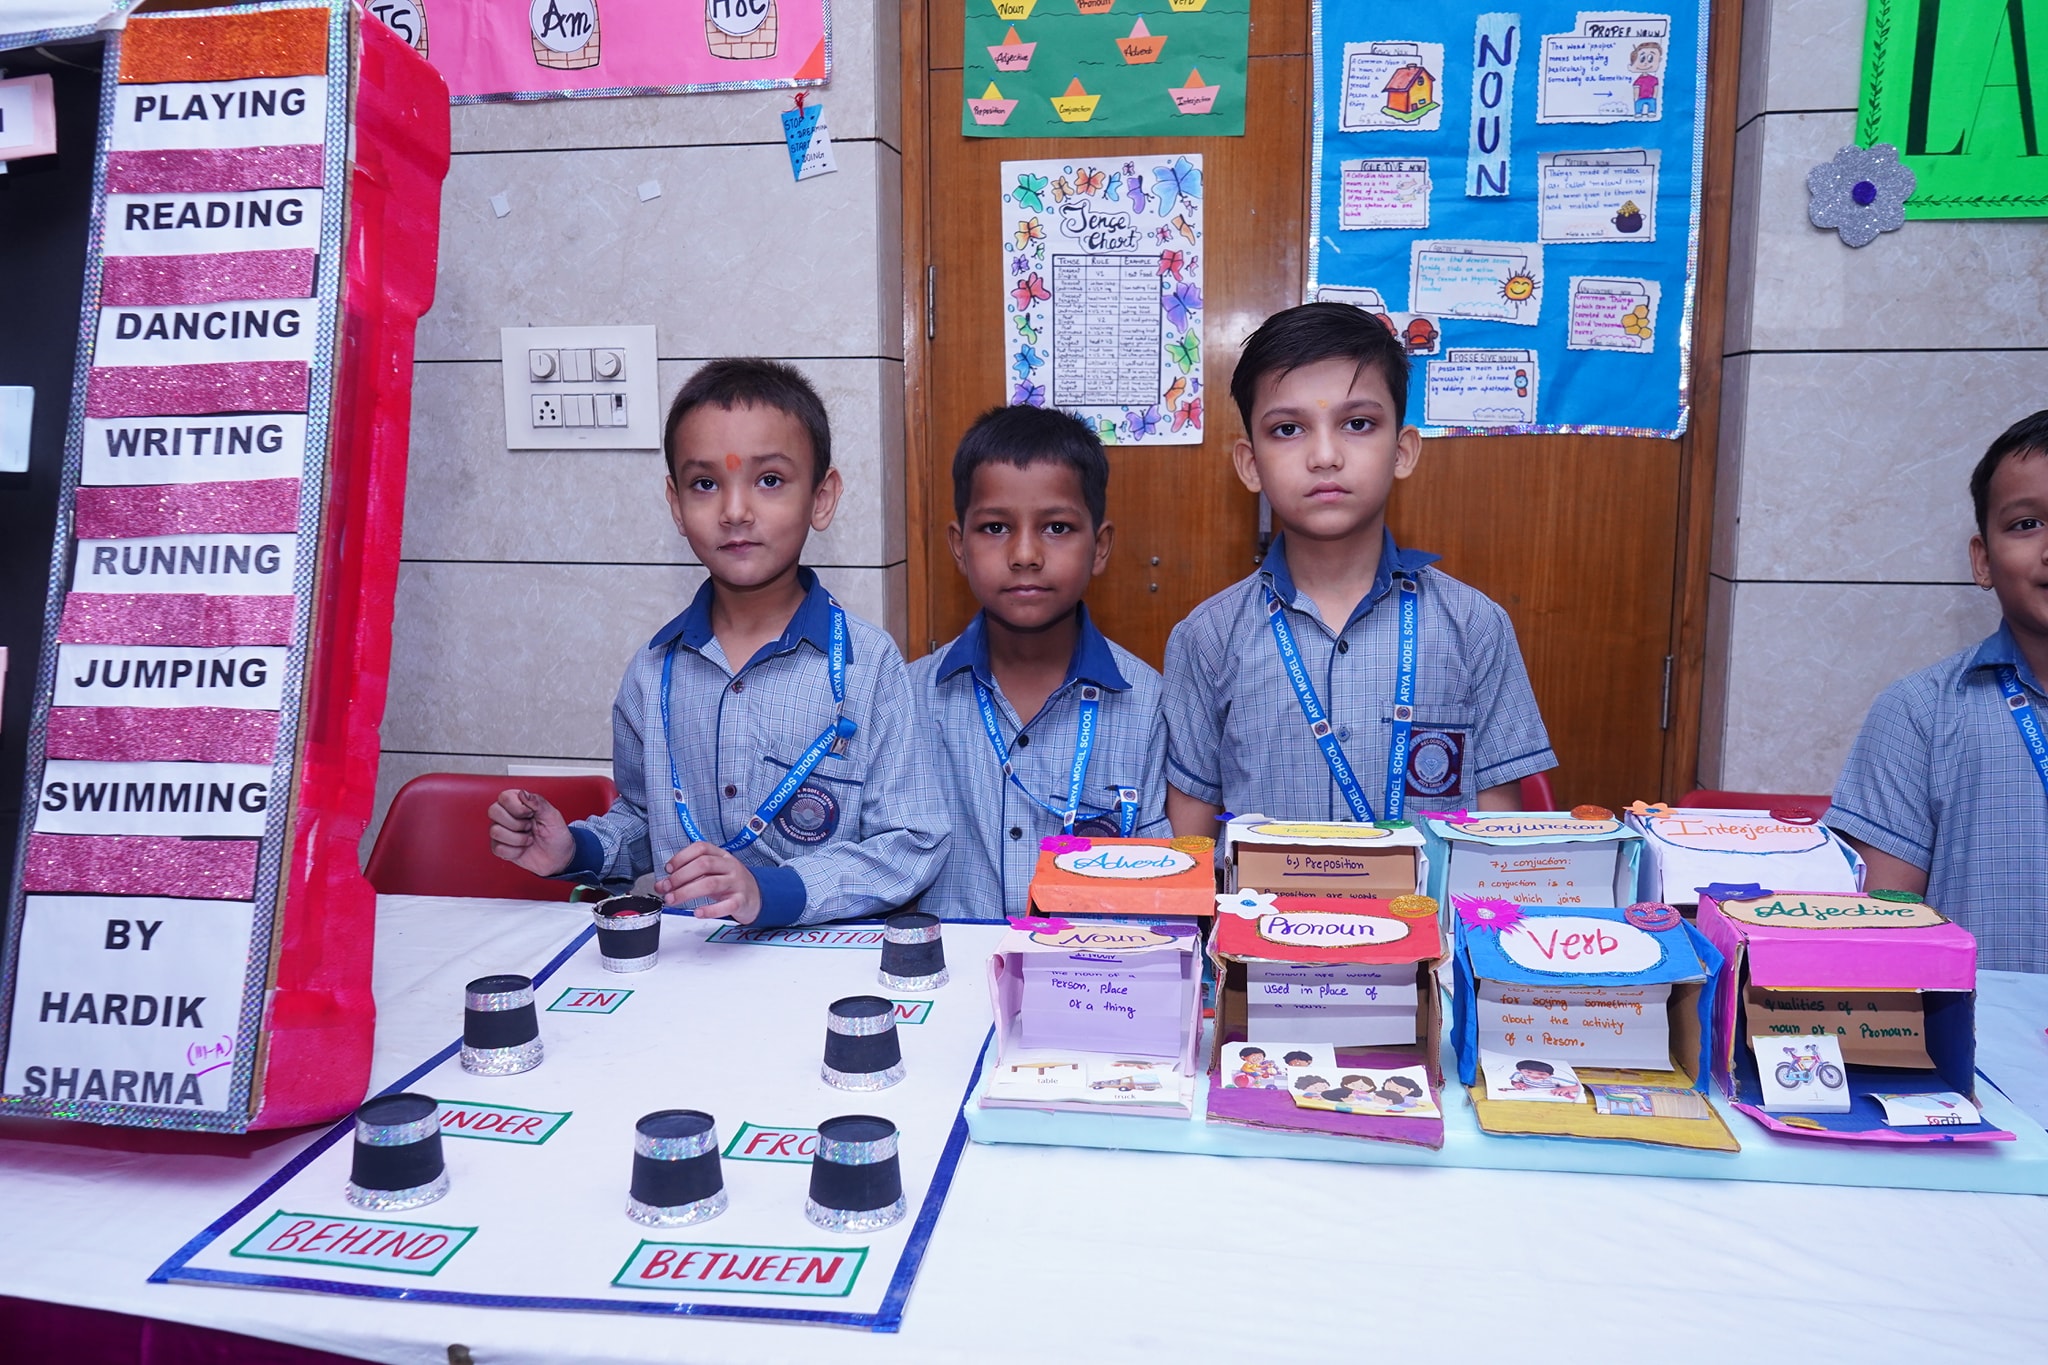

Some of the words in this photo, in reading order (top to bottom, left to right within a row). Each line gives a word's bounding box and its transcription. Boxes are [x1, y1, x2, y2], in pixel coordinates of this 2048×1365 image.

[541, 0, 591, 37] Am
[998, 3, 1024, 15] Noun
[995, 53, 1028, 65] Adjective
[1124, 44, 1153, 57] Adverb
[1550, 41, 1563, 50] The
[133, 89, 307, 122] PLAYING
[1059, 104, 1091, 115] Conjunction
[784, 117, 805, 131] STOP
[791, 140, 810, 154] START
[124, 199, 304, 231] READING
[1084, 230, 1137, 250] Chart
[1091, 257, 1110, 265] RULE
[1124, 257, 1152, 265] EXAMPLE
[115, 309, 301, 341] DANCING
[106, 425, 284, 457] WRITING
[92, 545, 282, 575] RUNNING
[833, 611, 843, 643] SCHOOL
[1403, 599, 1413, 637] SCHOOL
[1275, 617, 1295, 657] SCHOOL
[833, 644, 843, 672] MODEL
[1402, 637, 1413, 674] MODEL
[73, 658, 268, 689] JUMPING
[833, 672, 843, 699] ARYA
[1289, 655, 1308, 692] MODEL
[1400, 674, 1411, 703] ARYA
[983, 702, 997, 736] MODEL
[1303, 691, 1320, 719] ARYA
[818, 729, 836, 751] ARYA
[1080, 708, 1093, 749] SCHOOL
[2021, 714, 2046, 755] SCHOOL
[995, 735, 1007, 760] ARYA
[1392, 730, 1407, 775] SCHOOL
[794, 747, 822, 779] MODEL
[1073, 749, 1087, 786] MODEL
[1326, 741, 1352, 786] SCHOOL
[44, 781, 268, 814] SWIMMING
[764, 778, 798, 814] SCHOOL
[1069, 786, 1080, 809] ARYA
[1349, 785, 1370, 822] MODEL
[1389, 776, 1403, 815] MODEL
[681, 810, 700, 842] CHOOL
[1124, 804, 1134, 833] ARYA
[1463, 823, 1604, 833] Conjunction
[1660, 818, 1815, 841] Interjection
[1073, 852, 1177, 870] Adverb
[1305, 857, 1364, 872] Preposition
[1264, 888, 1316, 898] Peposition
[1350, 892, 1377, 900] words
[1548, 879, 1558, 887] is
[1513, 893, 1543, 903] which
[1557, 893, 1581, 905] joins
[1754, 901, 1916, 920] Adjective
[104, 919, 163, 950] BY
[1059, 933, 1146, 945] Noun
[1267, 917, 1375, 937] Pronoun
[1526, 928, 1619, 960] Verb
[567, 992, 617, 1008] IN
[1301, 984, 1313, 994] in
[1320, 983, 1349, 998] place
[1365, 986, 1378, 1001] of
[1500, 994, 1520, 1005] for
[39, 992, 206, 1028] HARDIK
[894, 1004, 921, 1019] N
[1069, 999, 1082, 1009] or
[1086, 1003, 1094, 1011] a
[1103, 1001, 1137, 1019] thing
[1838, 1001, 1853, 1016] of
[1867, 1002, 1878, 1012] a
[1502, 1014, 1535, 1025] about
[1550, 1015, 1569, 1025] the
[1582, 1017, 1625, 1036] activity
[1769, 1025, 1801, 1034] noun
[1811, 1024, 1825, 1035] or
[1837, 1026, 1847, 1035] a
[1859, 1022, 1919, 1039] Pronoun.
[1504, 1032, 1516, 1047] of
[1526, 1035, 1534, 1043] a
[1542, 1032, 1586, 1048] Person.
[23, 1066, 204, 1106] SHARMA
[744, 1132, 816, 1156] FRO
[267, 1219, 448, 1261] BEHIND
[640, 1249, 845, 1284] BETWEEN
